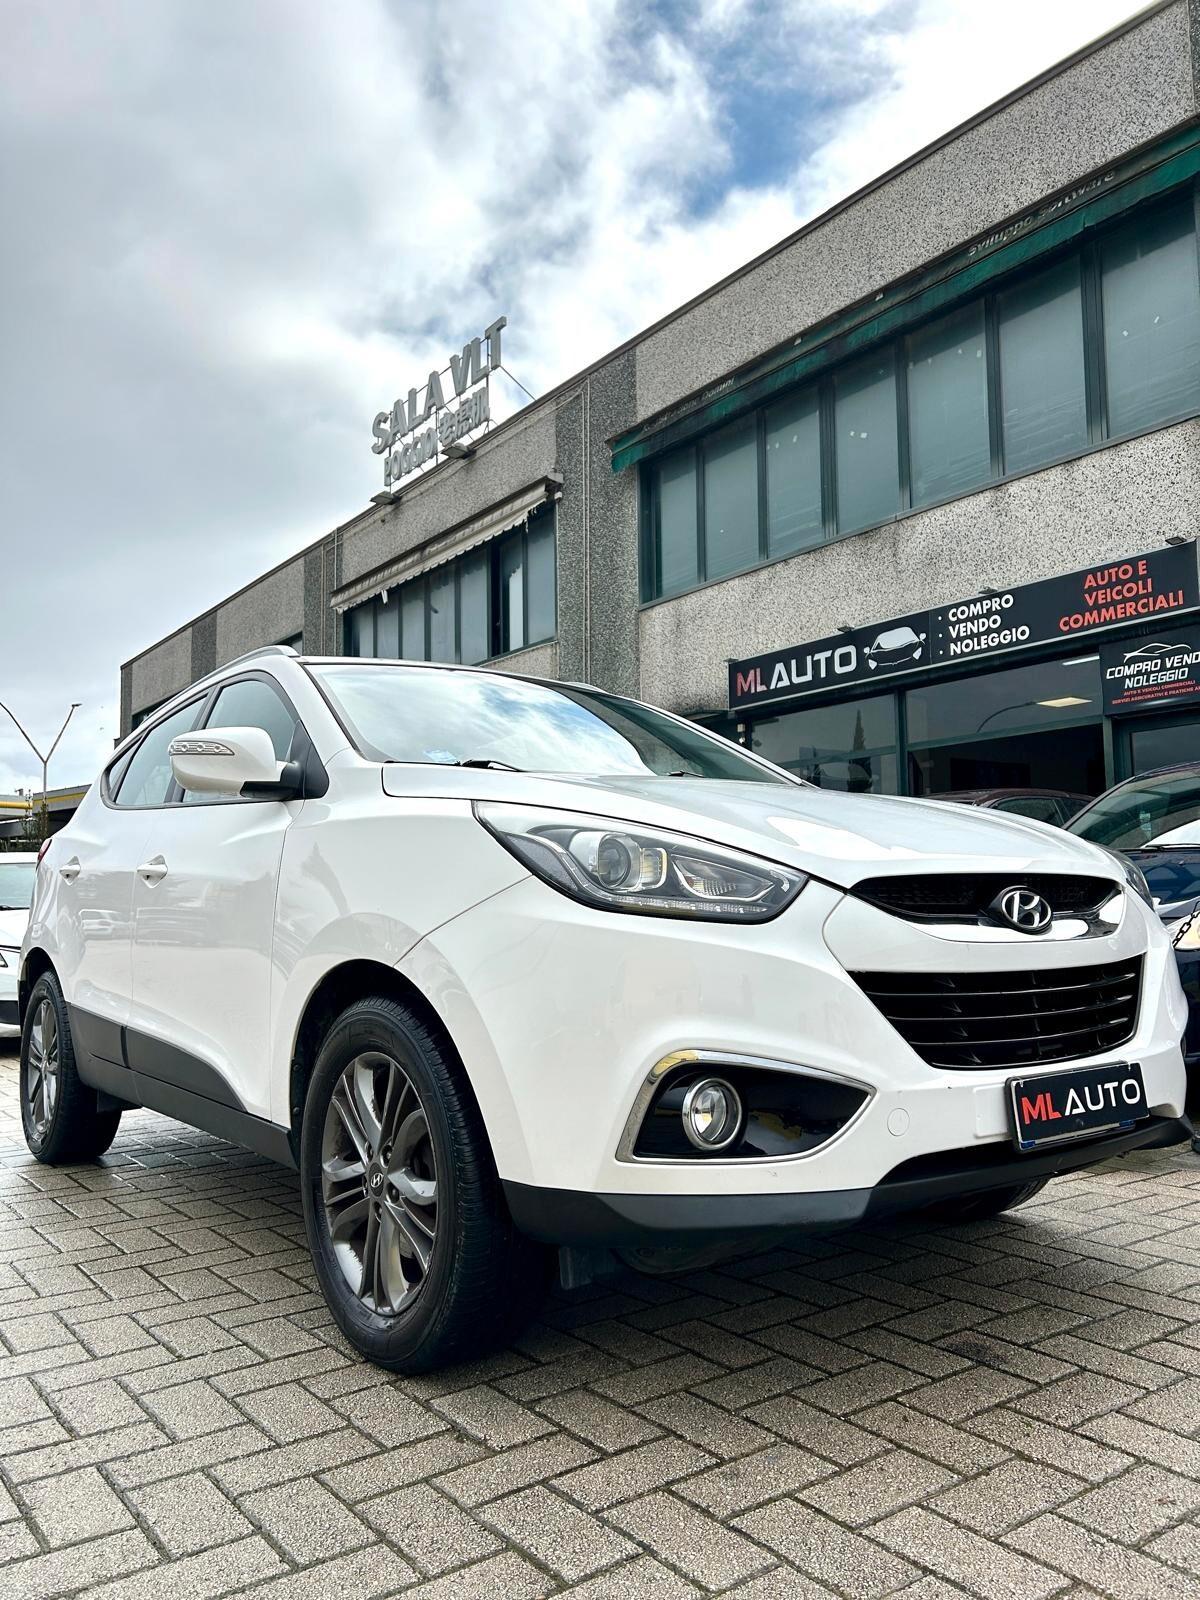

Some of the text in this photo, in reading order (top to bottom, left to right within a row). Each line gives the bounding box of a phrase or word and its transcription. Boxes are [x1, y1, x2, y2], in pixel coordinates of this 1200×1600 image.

[371, 316, 507, 455] SALA VLT
[1083, 560, 1148, 589] AUTO E
[1084, 578, 1153, 607] VEICOLI
[948, 594, 1014, 622] COMPRO
[1059, 590, 1184, 632] COMMERCIALI
[948, 614, 1002, 639] VENDO
[949, 626, 1030, 656] NOLEGGIO
[1106, 659, 1161, 680] COMPRO
[1124, 667, 1189, 689] NOLEGGIO
[1064, 1078, 1141, 1116] AUTO
